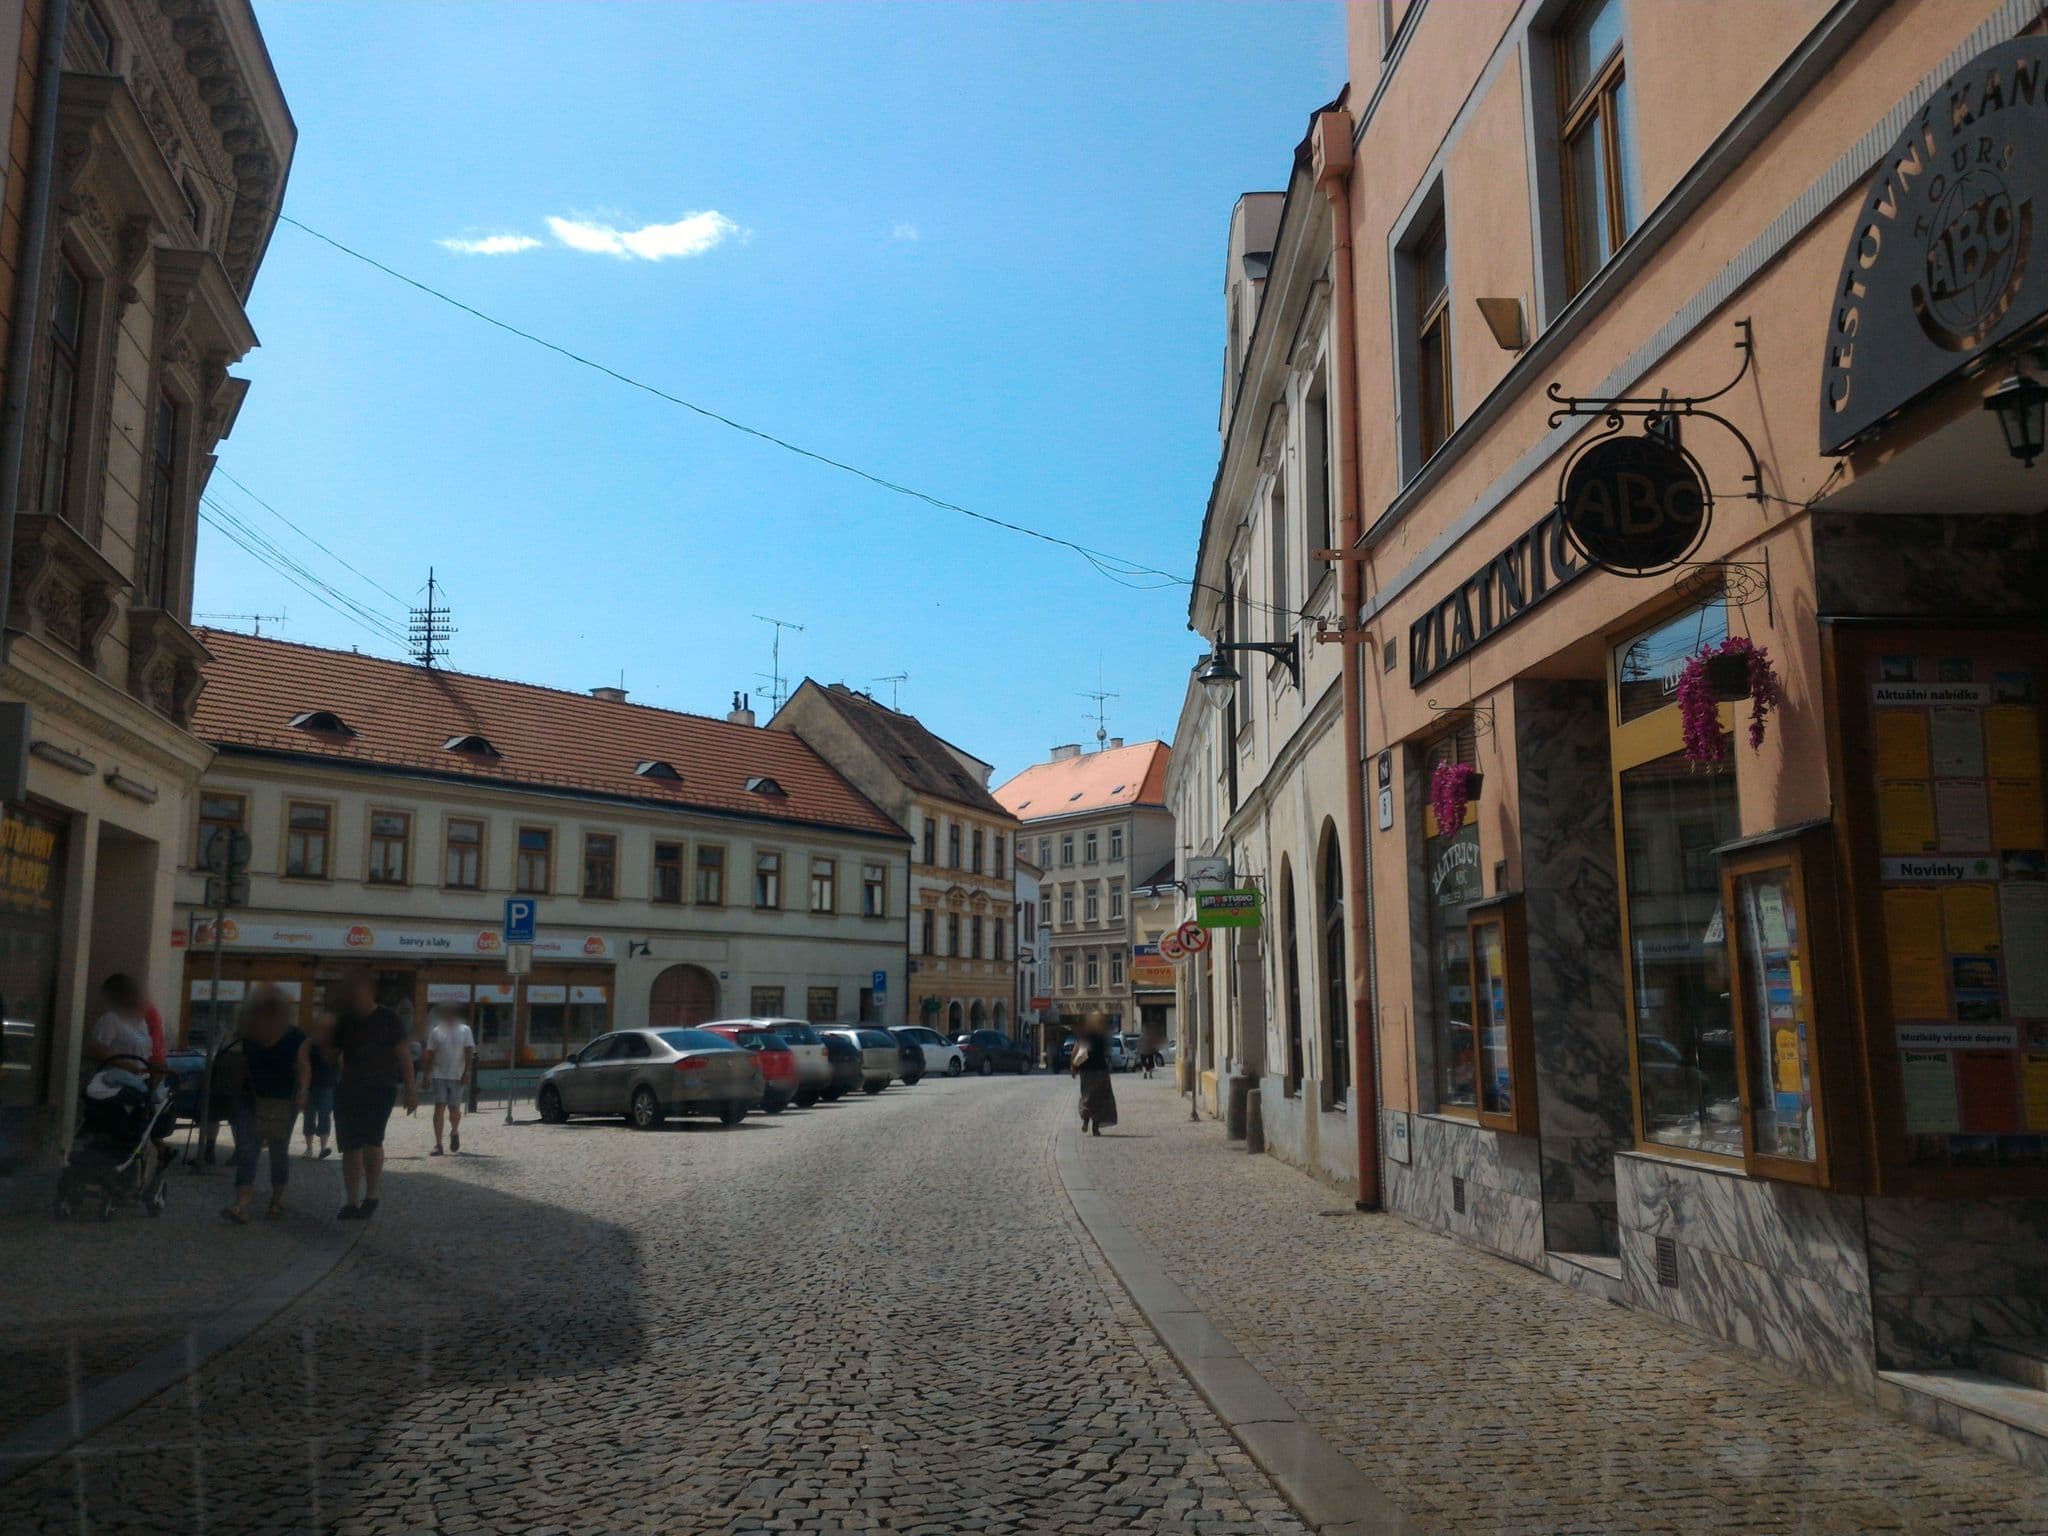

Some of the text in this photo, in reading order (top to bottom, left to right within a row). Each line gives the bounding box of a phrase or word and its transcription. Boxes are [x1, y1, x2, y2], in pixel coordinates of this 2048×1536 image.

[1913, 136, 2015, 239] TOURS
[1829, 57, 2048, 415] CESTOVNÍ KAN
[1926, 189, 2016, 300] ABC
[1573, 470, 1700, 537] ABC
[1412, 506, 1594, 686] ZLATNIC
[1876, 688, 1978, 701] Aktuální nabídka
[1901, 863, 1965, 880] Novinky
[511, 903, 529, 929] P
[875, 973, 883, 984] P
